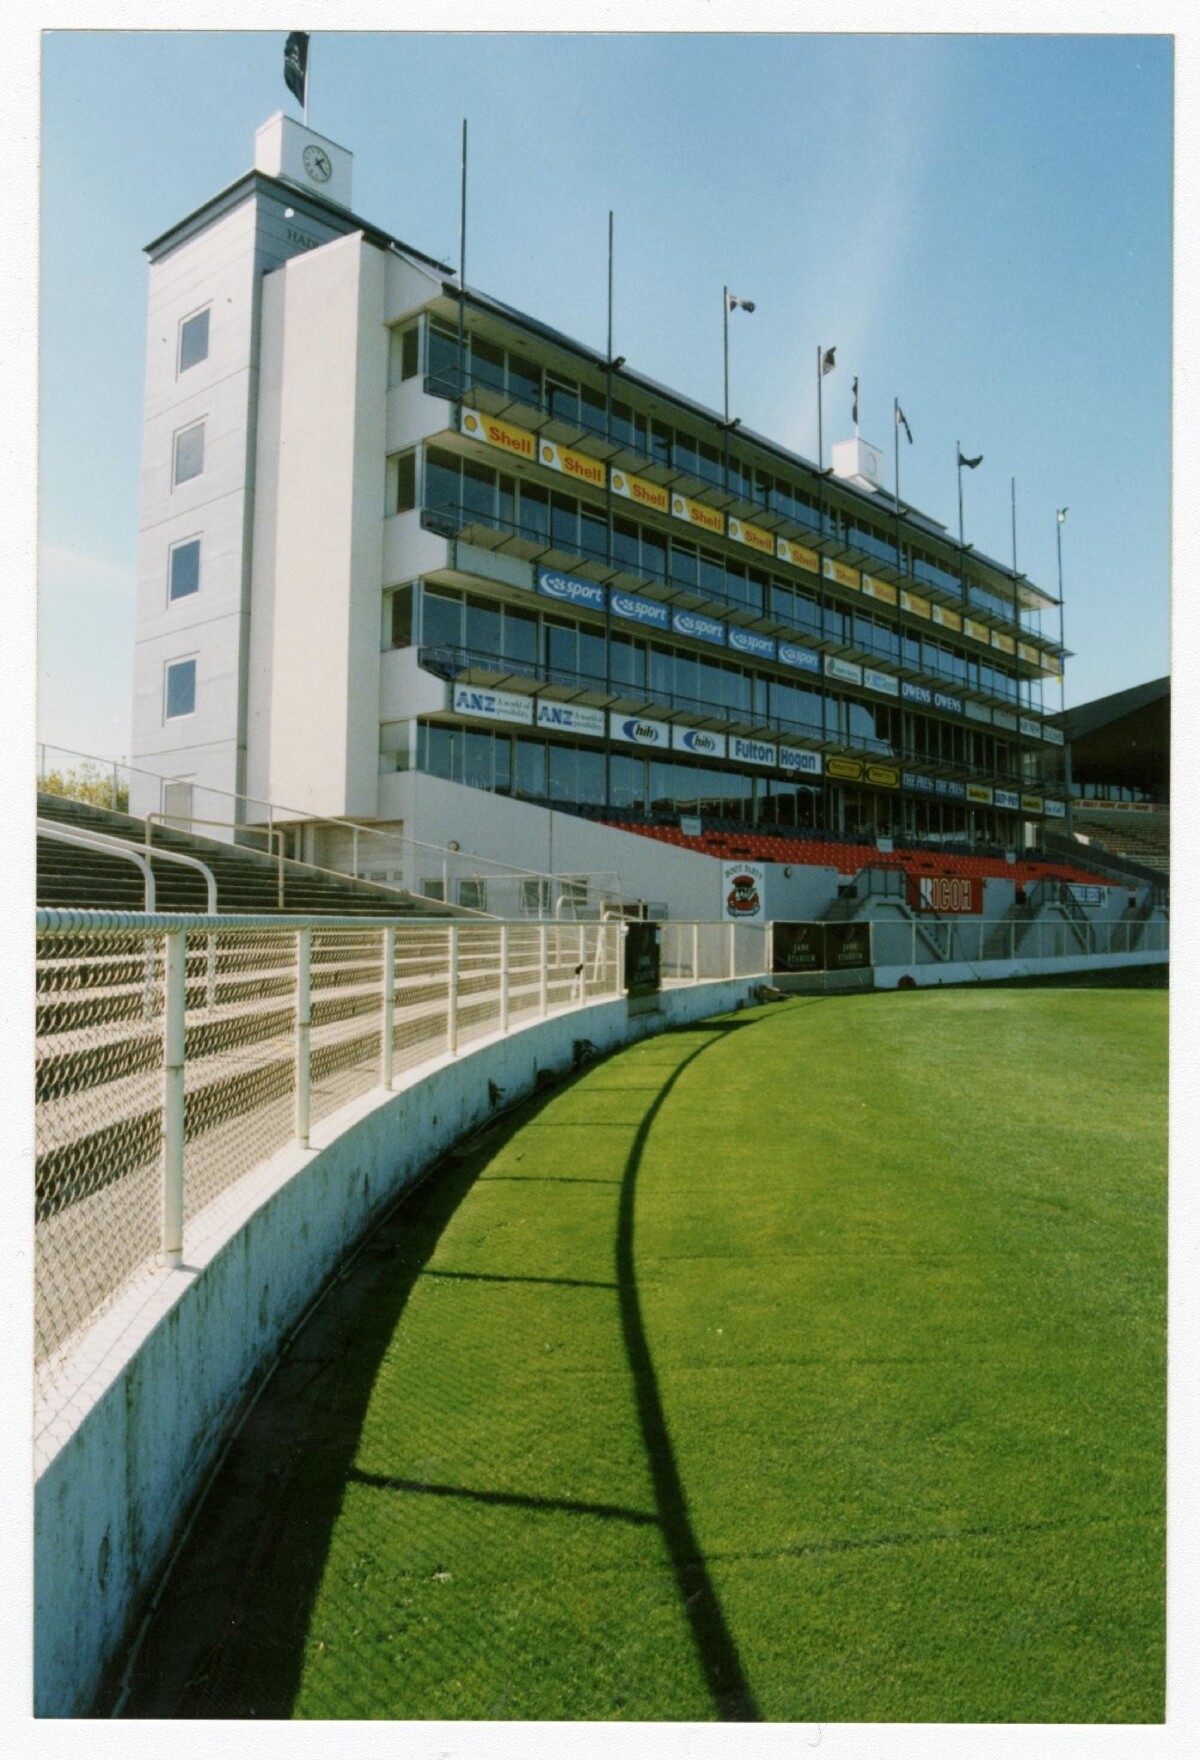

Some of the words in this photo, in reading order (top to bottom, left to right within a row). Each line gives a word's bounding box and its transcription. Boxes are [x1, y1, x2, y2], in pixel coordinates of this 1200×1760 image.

[489, 426, 531, 454] Shell
[564, 457, 602, 482] Shell
[632, 483, 665, 507] Shell
[691, 508, 721, 530] Shell
[744, 530, 772, 550] Shell
[792, 550, 817, 569] Shell
[836, 567, 858, 585] Shell
[566, 581, 603, 602] sport
[635, 601, 666, 621] sport
[695, 620, 723, 637] sport
[748, 636, 774, 652] sport
[795, 650, 818, 665] sport
[456, 691, 496, 713] ANZ
[902, 682, 931, 703] OWENS
[934, 693, 962, 713] OWENS
[538, 706, 573, 726] ANZ
[635, 723, 654, 739] hih
[694, 735, 711, 749] hih
[735, 739, 774, 763] Fulton
[781, 748, 816, 771] Hogan
[920, 877, 972, 911] RICOH
